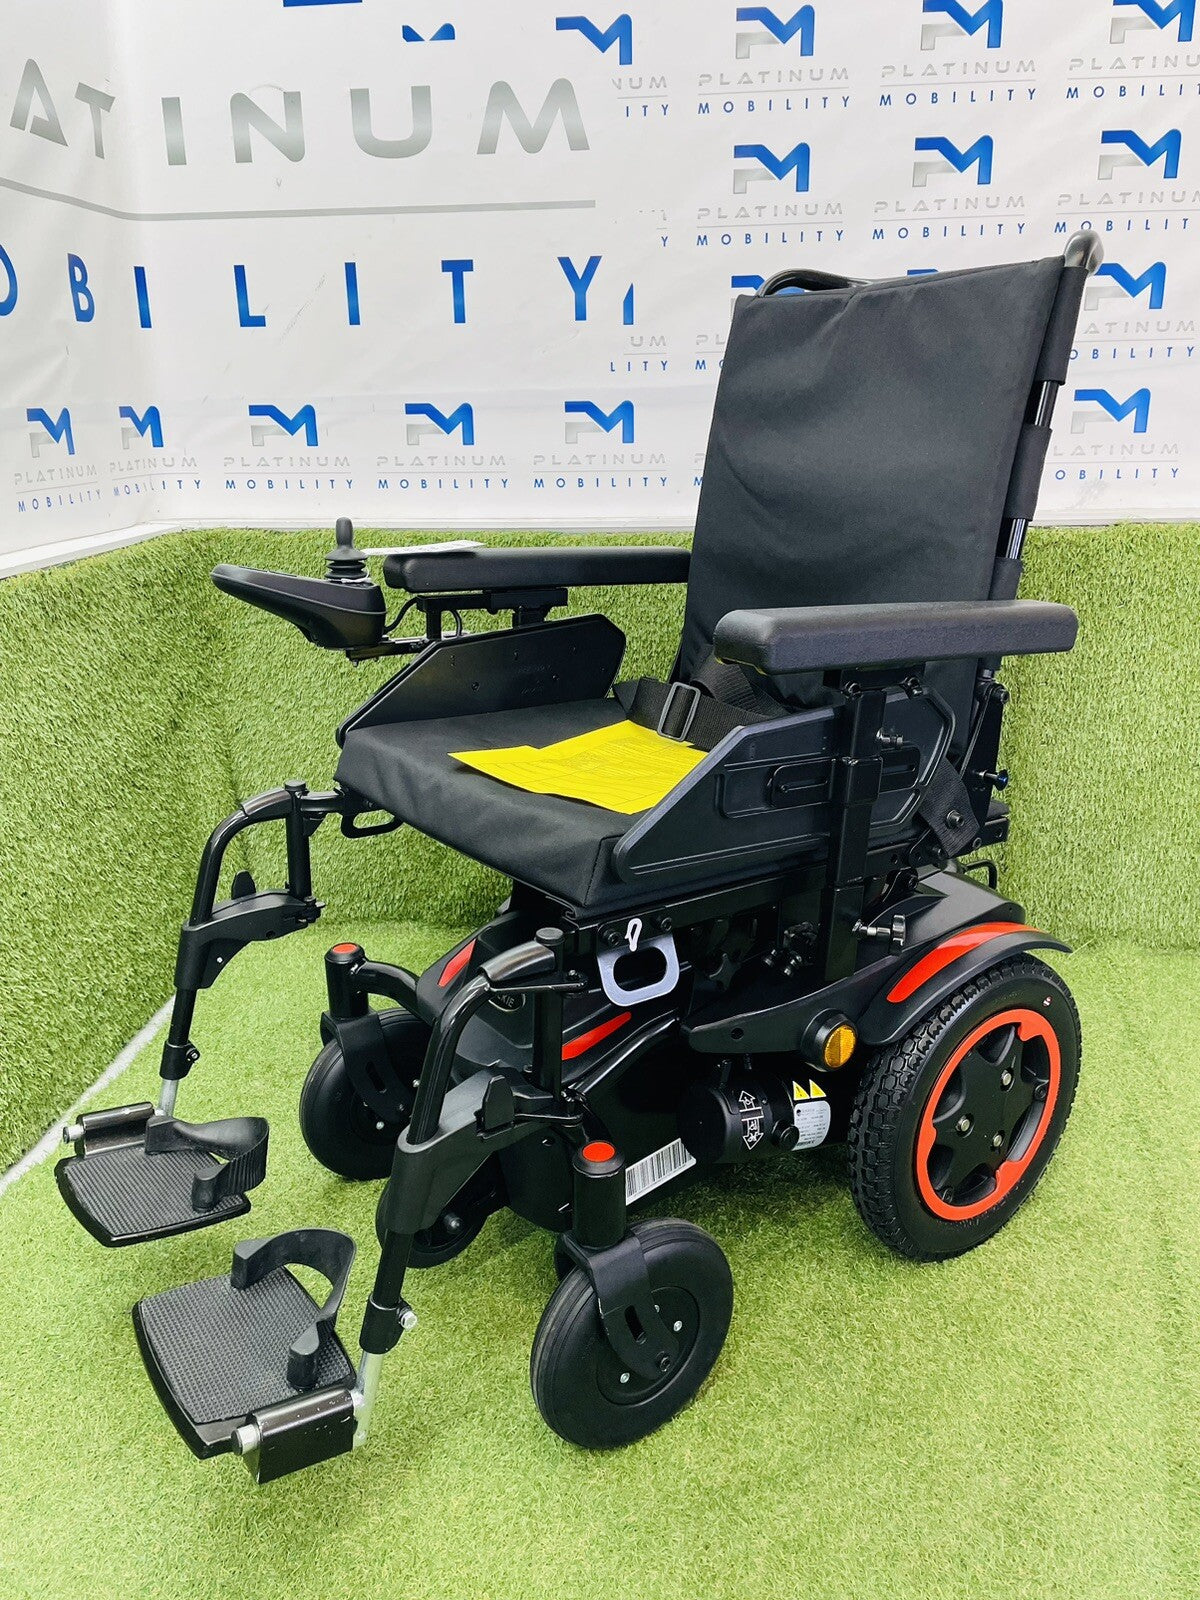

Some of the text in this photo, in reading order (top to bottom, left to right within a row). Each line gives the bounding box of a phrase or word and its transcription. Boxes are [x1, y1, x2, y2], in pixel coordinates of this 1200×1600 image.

[698, 67, 849, 87] PLATINUM
[880, 59, 1036, 78] PLATINUM
[698, 96, 850, 114] MOBILITY
[879, 88, 1036, 106] MOBILITY
[697, 203, 843, 220] PLATINUM
[872, 195, 1026, 213] PLATINUM
[696, 230, 844, 246] MOBILITY
[872, 222, 1026, 240] MOBILITY
[109, 456, 197, 473] PLATINUM
[223, 456, 350, 467] PLATINUM
[377, 455, 506, 466] PLATINUM
[533, 453, 666, 465] PLATINUM
[14, 465, 97, 485] PLATINUM
[533, 476, 667, 489] MOBILITY
[113, 479, 201, 497] MOBILITY
[225, 479, 353, 490] MOBILITY
[378, 478, 509, 490] MOBILITY
[18, 489, 102, 512] MOBILITY
